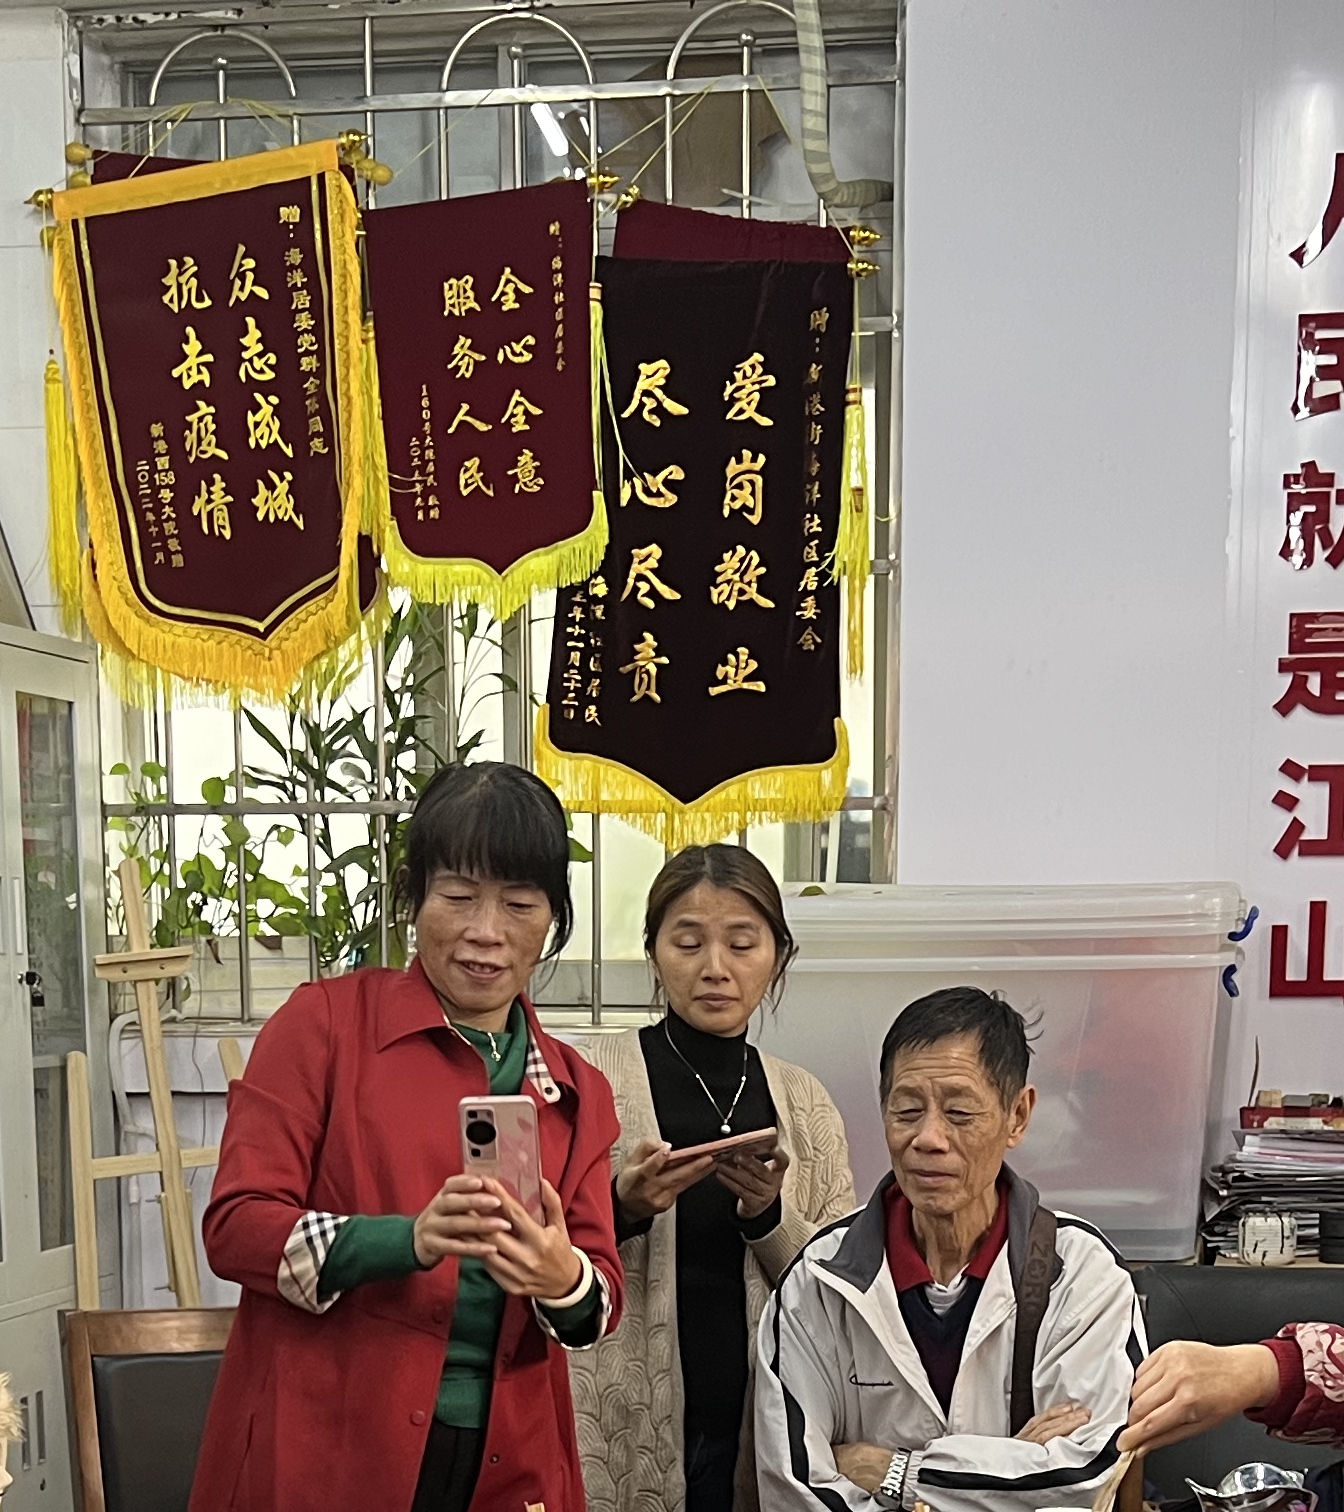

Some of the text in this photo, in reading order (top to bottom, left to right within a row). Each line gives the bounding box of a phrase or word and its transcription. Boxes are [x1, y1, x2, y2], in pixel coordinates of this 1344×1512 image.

[160, 255, 235, 541] 抗击疫情
[227, 242, 306, 532] 众志成城
[442, 274, 495, 498] 服务人民
[490, 265, 545, 495] 全心全意
[618, 357, 691, 707] 尽心尽责
[708, 352, 779, 699] 爱岗敬业
